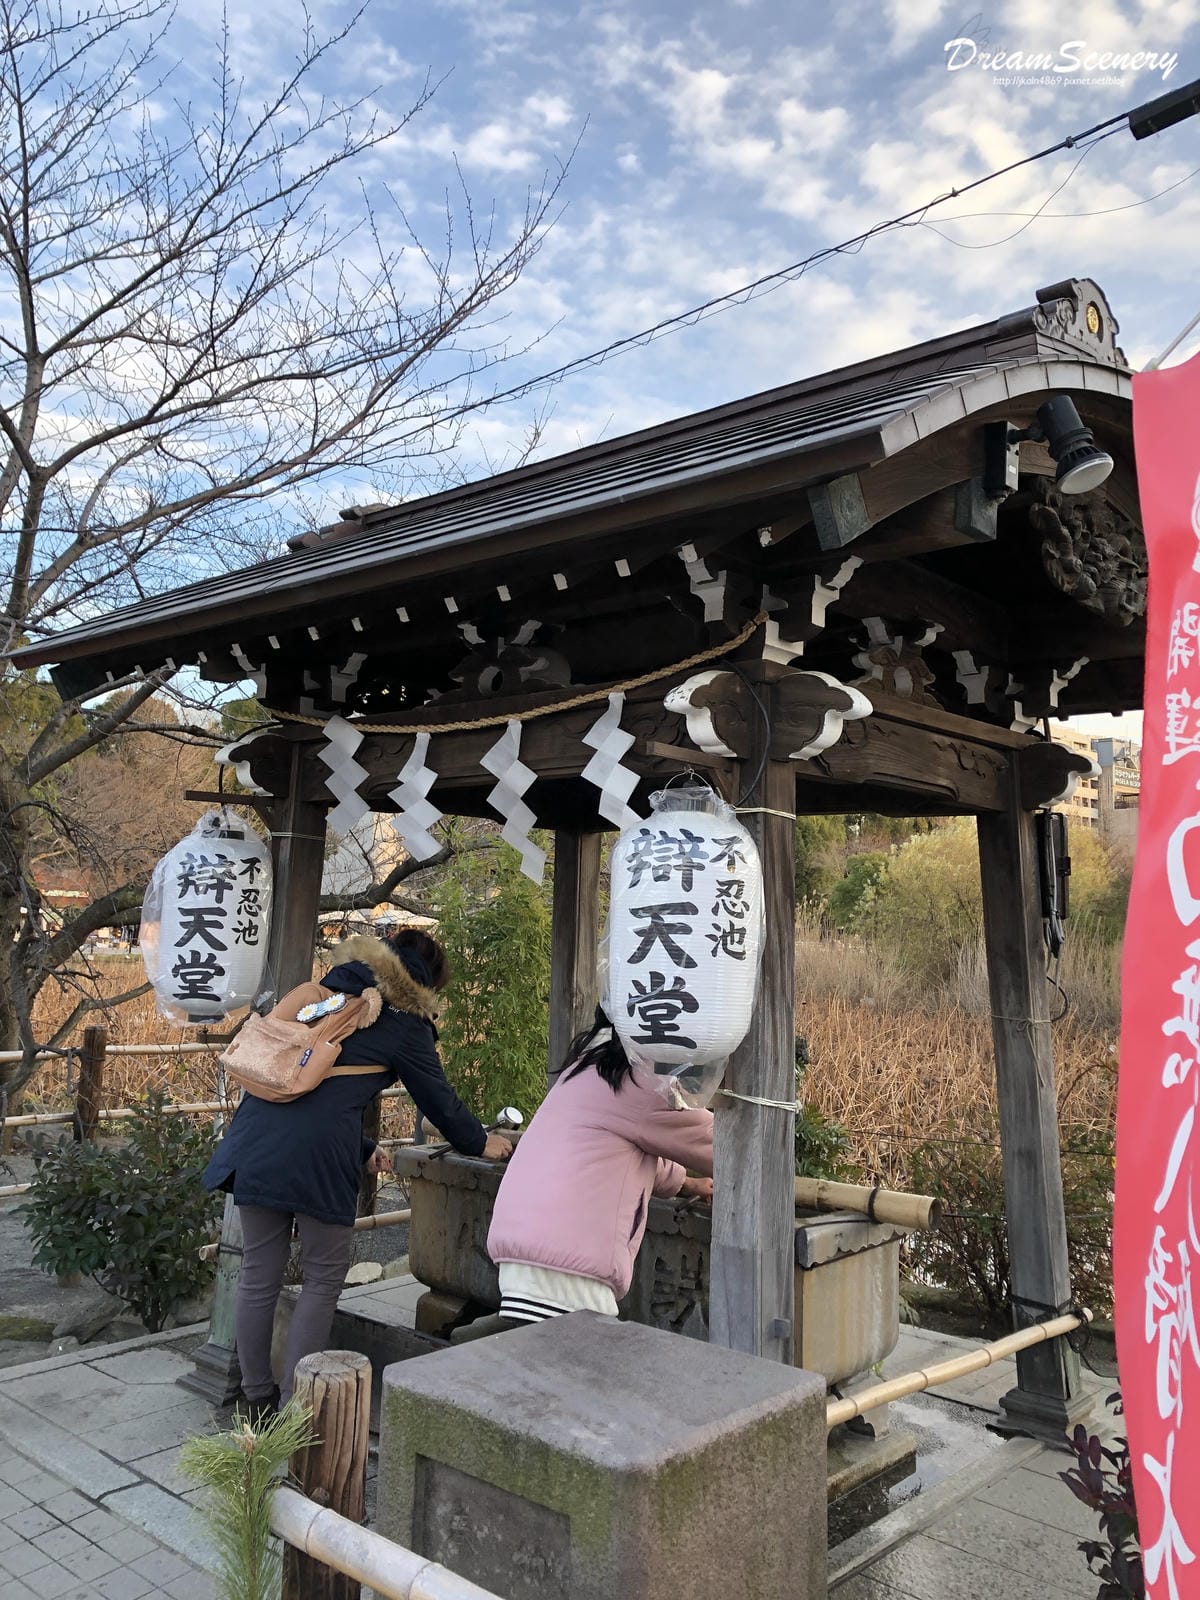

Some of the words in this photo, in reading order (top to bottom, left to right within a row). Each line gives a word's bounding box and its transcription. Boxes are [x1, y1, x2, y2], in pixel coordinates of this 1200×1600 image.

[232, 857, 262, 946] 不忍池
[705, 835, 750, 960] 不忍池
